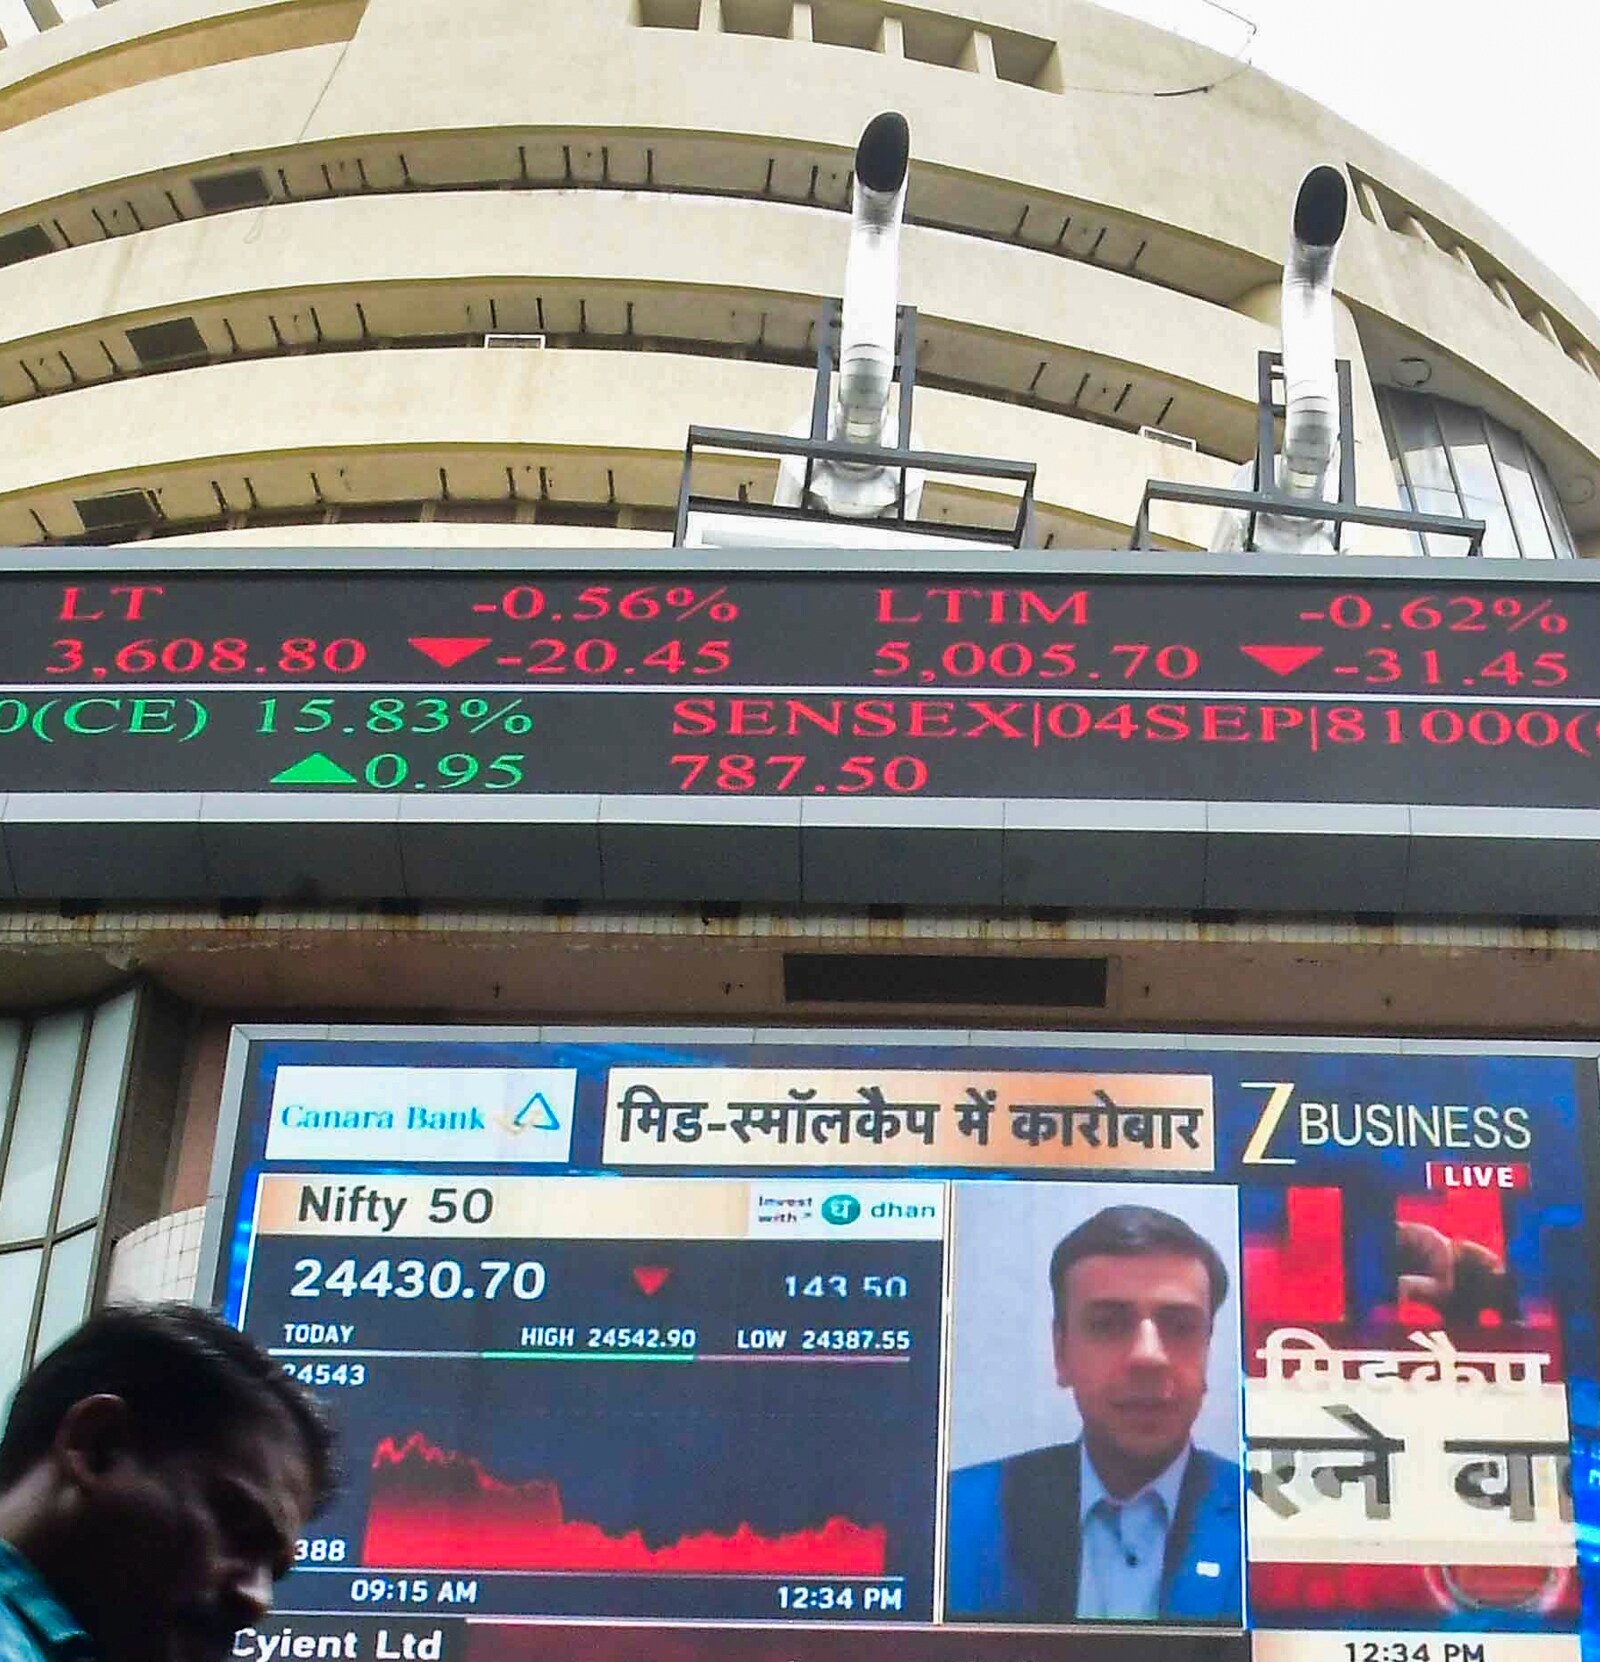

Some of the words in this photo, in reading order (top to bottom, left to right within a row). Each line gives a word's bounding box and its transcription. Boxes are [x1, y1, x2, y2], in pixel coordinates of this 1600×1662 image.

[58, 586, 165, 622] LT
[471, 587, 740, 624] -0.56%
[874, 588, 1090, 627] LTIM
[1297, 594, 1570, 635] -0.62%
[45, 638, 367, 680] 3,608.80
[495, 639, 733, 676] -20.45
[873, 643, 1200, 685] 5,005.70
[1332, 650, 1570, 688] -31.45
[256, 698, 534, 737] 15.83%
[363, 754, 526, 791] 0.95
[669, 754, 928, 793] 787.50
[280, 1104, 394, 1132] Canara
[405, 1105, 486, 1132] Bank
[617, 1084, 940, 1148] मिड-स्मॉलकैप
[955, 1088, 999, 1146] में
[1008, 1089, 1204, 1150] कारोबार
[1301, 1102, 1533, 1150] BUSINESS
[1443, 1165, 1515, 1189] LIVE
[297, 1185, 406, 1232] Nifty
[427, 1187, 494, 1225] 50
[870, 1203, 937, 1219] dhan
[290, 1258, 547, 1300] 24430.70
[784, 1274, 910, 1299] 14350
[283, 1323, 356, 1344] TODAY
[521, 1326, 575, 1348] HIGH
[588, 1327, 697, 1350] 24542.90
[737, 1327, 787, 1350] LOW
[802, 1328, 911, 1352] 24387.55
[351, 1579, 429, 1603] 09:15
[437, 1581, 478, 1604] AM
[776, 1586, 854, 1611] 12:34
[862, 1588, 903, 1611] PM
[232, 1628, 357, 1662] Cyient
[376, 1629, 444, 1662] Ltd
